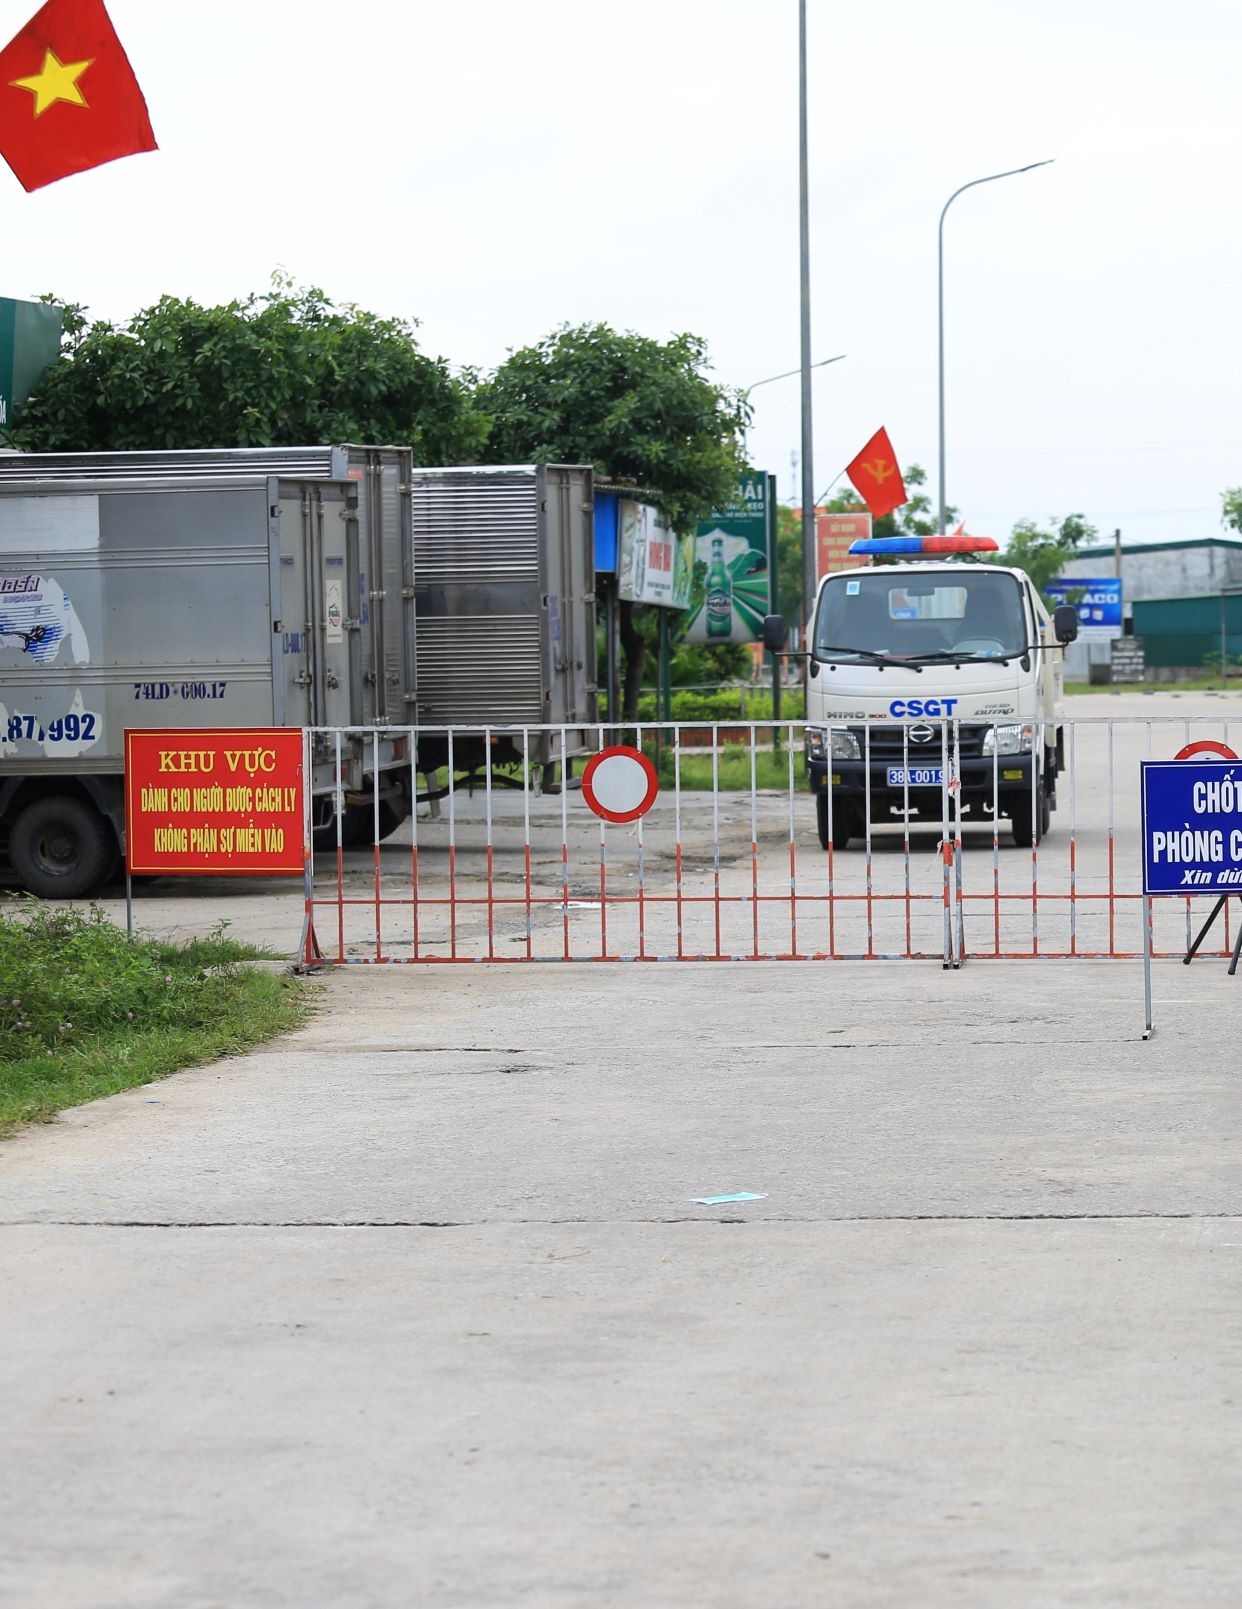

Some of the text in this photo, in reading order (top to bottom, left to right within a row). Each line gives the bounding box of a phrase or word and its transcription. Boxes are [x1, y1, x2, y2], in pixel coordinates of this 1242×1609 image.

[1050, 593, 1119, 604] PACO
[826, 711, 866, 719] HINO
[890, 699, 958, 718] CSGT
[159, 747, 276, 778] KHU VỰC
[141, 781, 296, 818] DÀNH CHO NGƯỜI ĐƯỢC CÁCH LY
[154, 819, 284, 858] KHÔNG PHẬN SỰ MIỄN VÀO
[1152, 823, 1224, 863] PHÒNG
[1180, 869, 1212, 885] Xin
